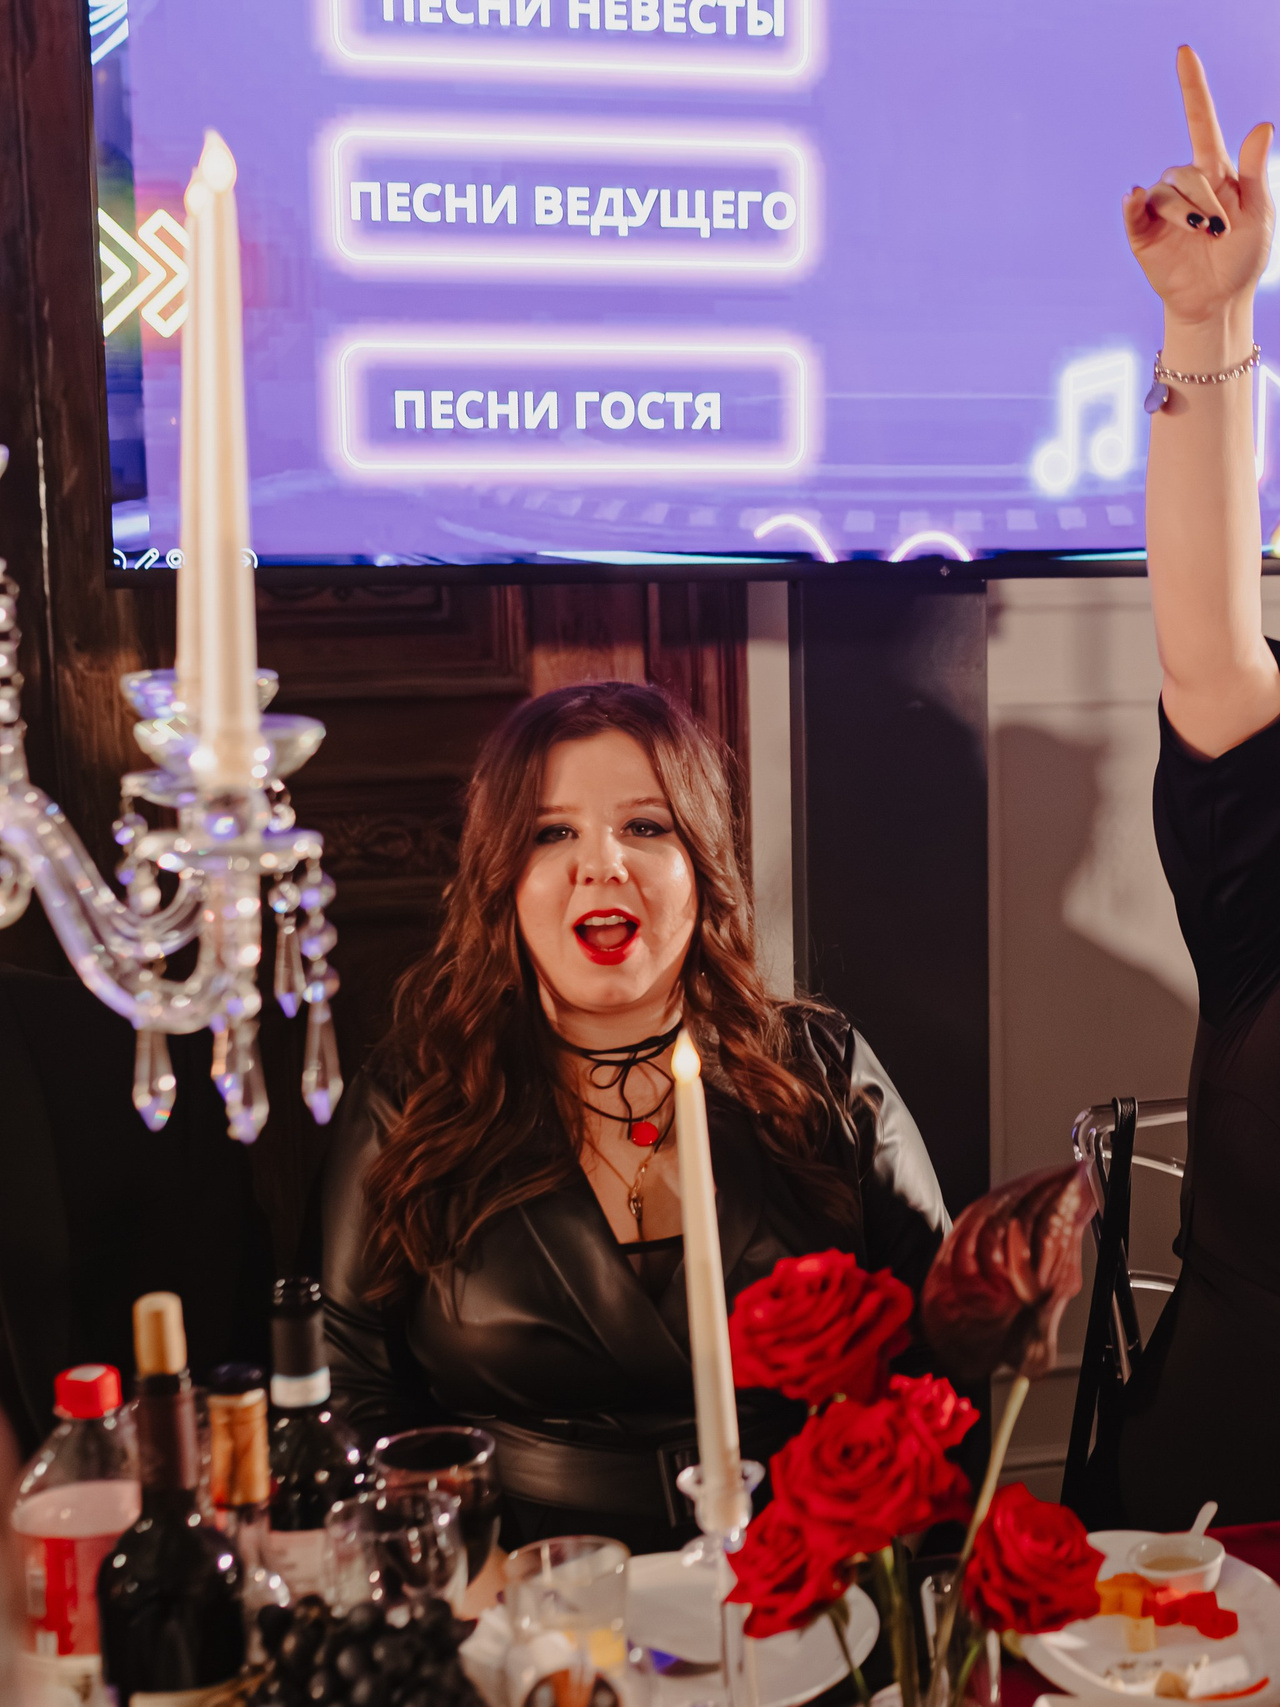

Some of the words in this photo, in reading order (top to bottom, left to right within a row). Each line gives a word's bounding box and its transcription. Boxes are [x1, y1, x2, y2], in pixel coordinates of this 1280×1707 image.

[382, 0, 551, 28] ПЕСНИ
[568, 0, 785, 37] НЕВЕСТЫ
[350, 181, 517, 225] ПЕСНИ
[534, 185, 797, 238] ВЕДУЩЕГО
[394, 390, 558, 430] ПЕСНИ
[575, 391, 721, 430] ГОСТЯ
